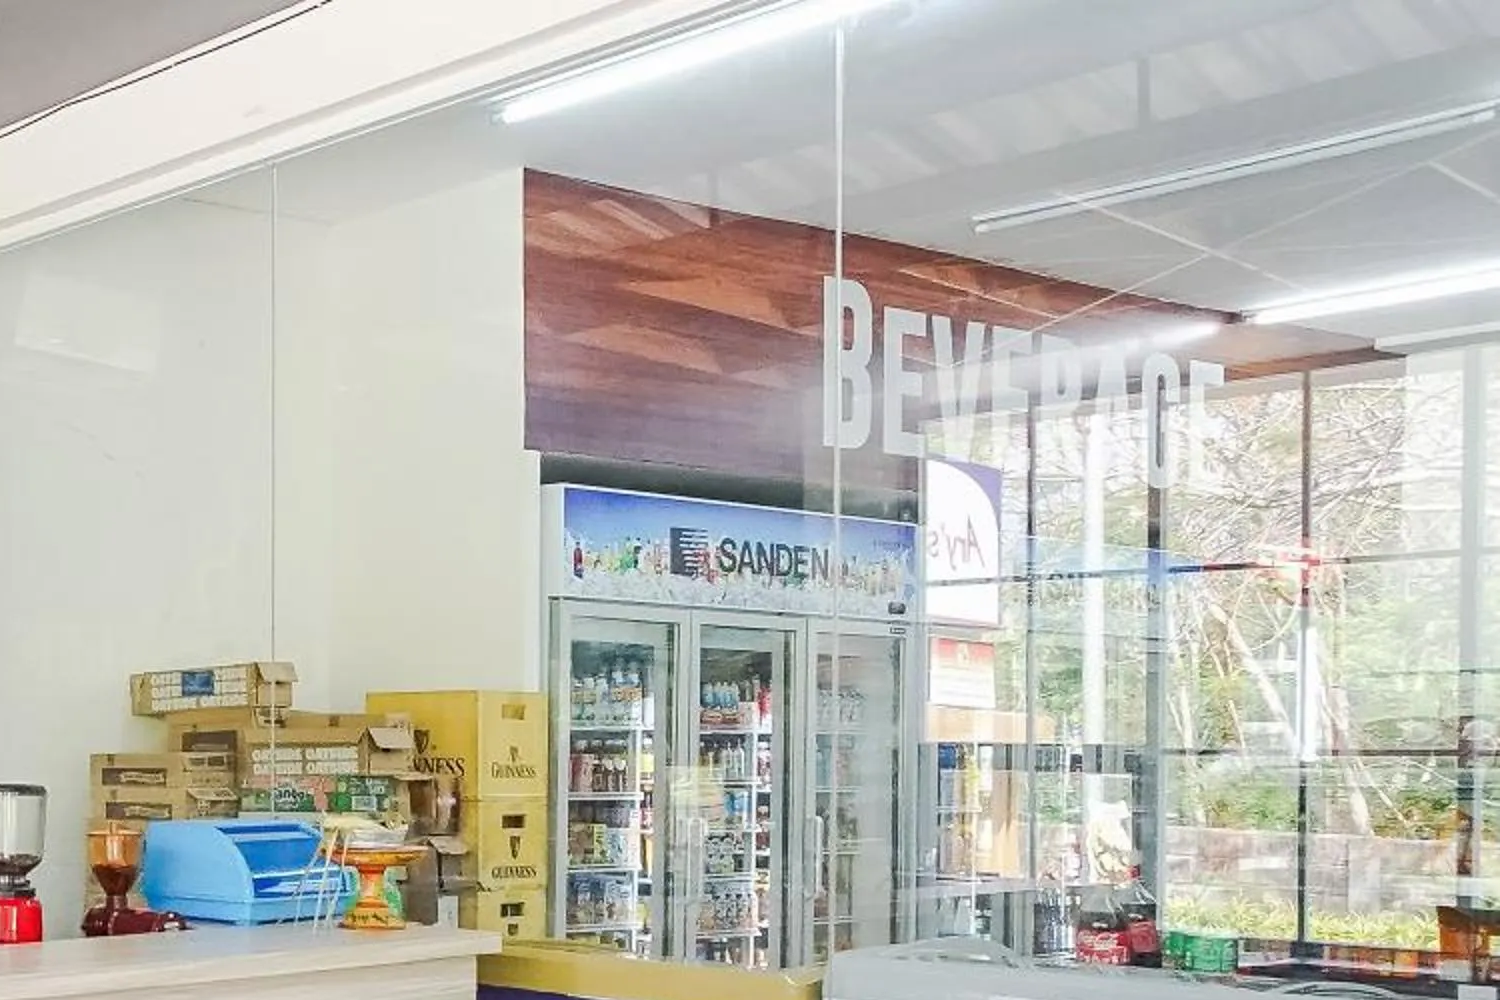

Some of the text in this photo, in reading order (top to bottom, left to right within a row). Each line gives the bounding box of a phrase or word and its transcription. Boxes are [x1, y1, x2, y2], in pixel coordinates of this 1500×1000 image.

[718, 536, 829, 580] SANDEN
[490, 761, 537, 779] GUINNESS
[491, 865, 537, 880] GUINNESS
